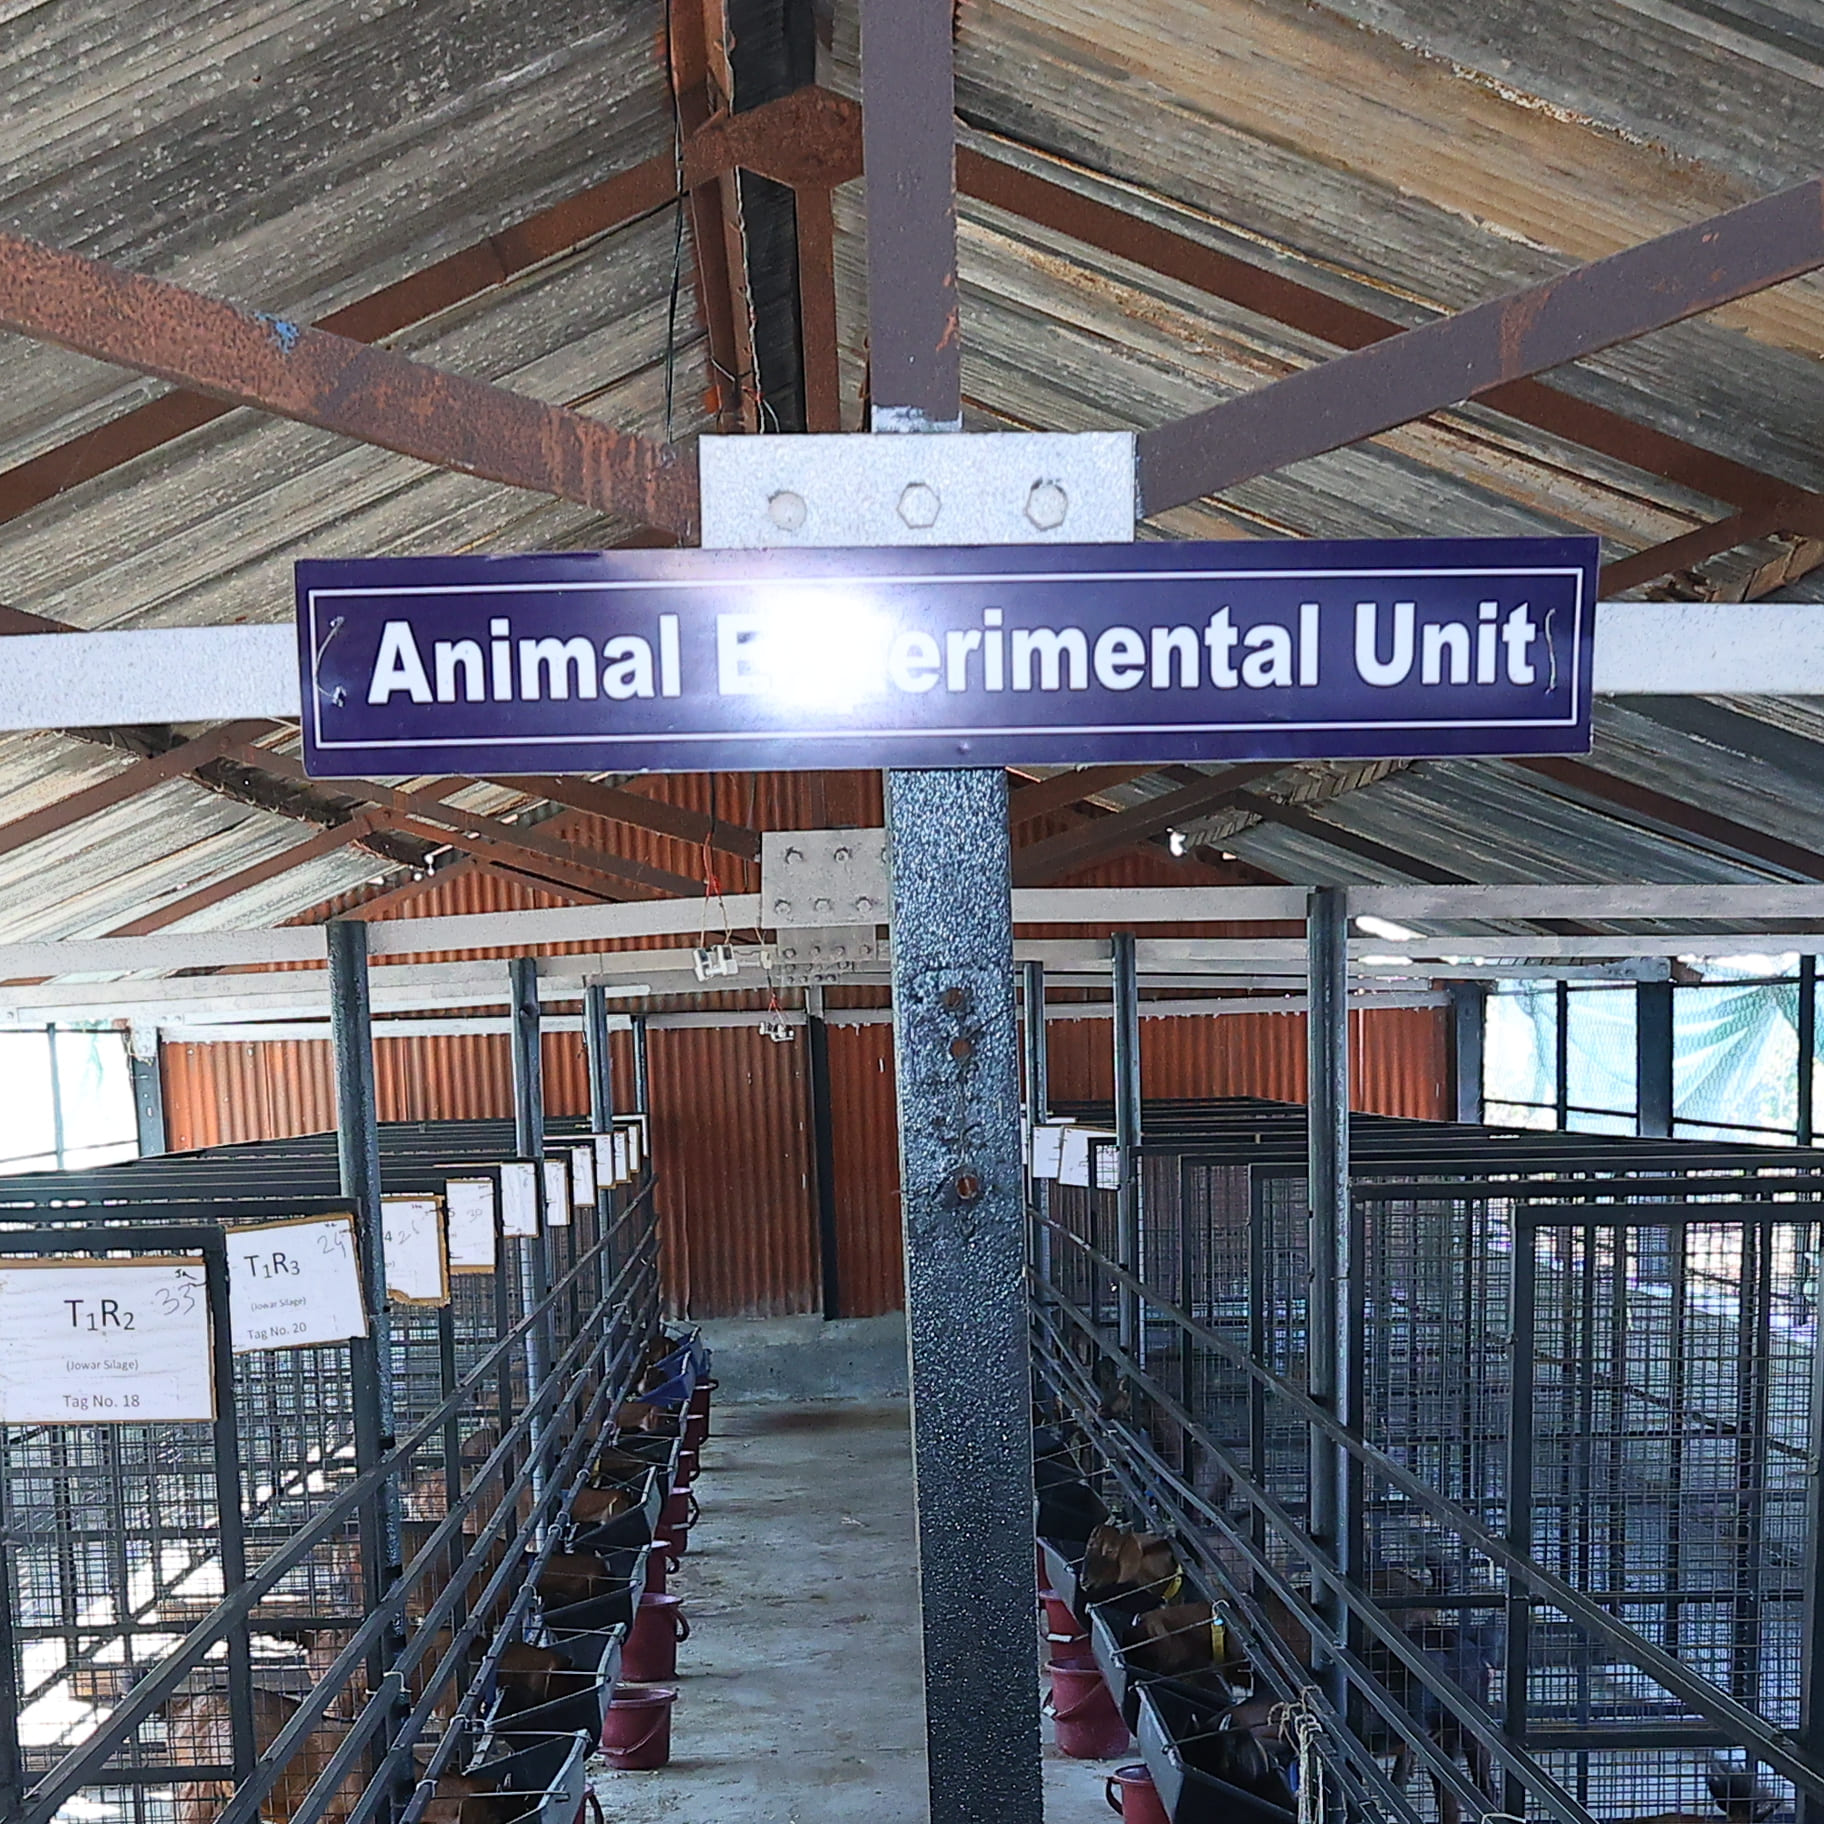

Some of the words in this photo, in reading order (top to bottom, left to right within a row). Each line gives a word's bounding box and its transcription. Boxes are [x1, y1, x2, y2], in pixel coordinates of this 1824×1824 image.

[367, 613, 682, 704] Animal
[716, 602, 1319, 712] Eerimental
[1354, 601, 1536, 686] Unit
[247, 1329, 268, 1342] Tag
[270, 1325, 290, 1337] No.
[293, 1321, 308, 1334] 20
[66, 1360, 101, 1373] (Jowar
[103, 1359, 139, 1372] Silage)
[62, 1394, 89, 1411] Tag
[92, 1394, 119, 1408] No.
[123, 1394, 141, 1408] 18
